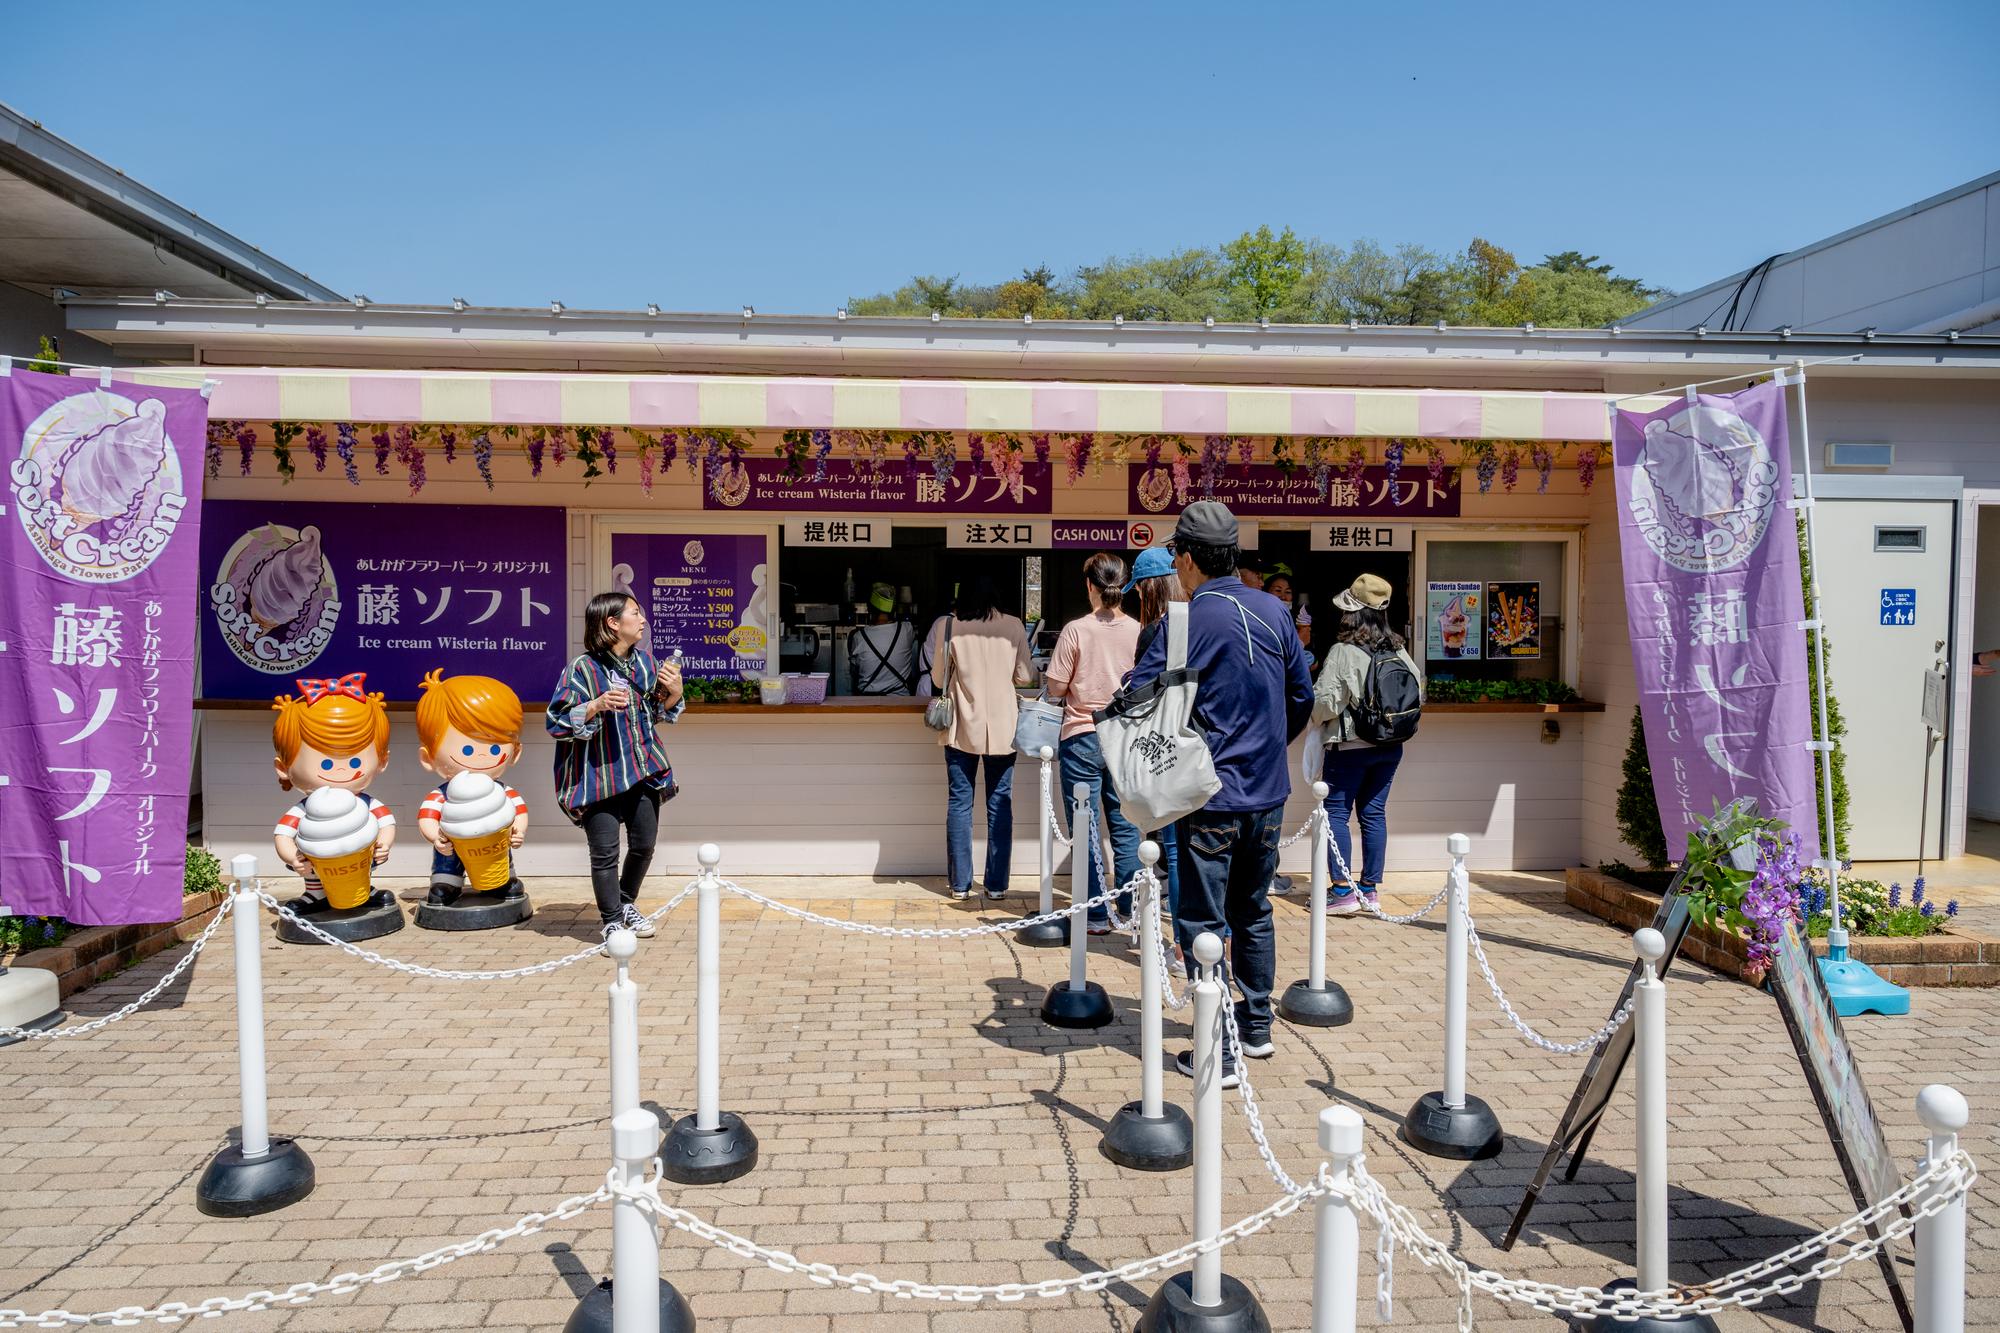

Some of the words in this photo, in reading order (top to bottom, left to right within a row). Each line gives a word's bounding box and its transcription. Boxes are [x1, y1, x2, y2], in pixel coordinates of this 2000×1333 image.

[756, 488, 774, 499] Ice
[778, 490, 814, 499] cream
[818, 488, 866, 499] Wisteria
[870, 489, 906, 500] flavor
[916, 472, 1038, 504] 藤ソフト
[1330, 477, 1447, 508] 藤ソフト
[1237, 493, 1283, 504] Wisteria
[1287, 493, 1320, 505] flavor
[10, 458, 78, 541] Soft
[62, 492, 187, 567] Cream
[804, 521, 872, 543] 提供口
[965, 523, 1032, 544] 注文口
[1053, 528, 1087, 541] CASH
[1090, 528, 1125, 541] ONLY
[1329, 526, 1393, 547] 提供口
[26, 522, 67, 571] Ashikaga
[69, 565, 119, 579] Flower
[122, 555, 151, 576] Park
[356, 558, 489, 574] あしかがフラワーパーク
[492, 560, 551, 575] オリジナル
[707, 587, 734, 597] ¥500
[1430, 583, 1456, 591] Wisteria
[1457, 583, 1480, 591] Sundae
[356, 584, 551, 627] 藤ソフト
[707, 603, 734, 613] ¥500
[210, 582, 263, 643] Soft
[254, 599, 343, 662] Cream
[653, 619, 688, 628] バニラ
[707, 619, 734, 629] ¥450
[224, 631, 258, 666] Ashikaga
[260, 660, 296, 672] Flower
[297, 650, 319, 667] Park
[358, 635, 381, 649] Ice
[387, 637, 432, 649] cream
[438, 636, 498, 650] Wisteria
[502, 637, 547, 651] flavor
[681, 656, 727, 670] Wisteria
[730, 655, 765, 670] flavor
[139, 600, 163, 778] あしかがフラワーパーク
[46, 602, 124, 899] 藤ソフト
[133, 795, 157, 876] オリジナル
